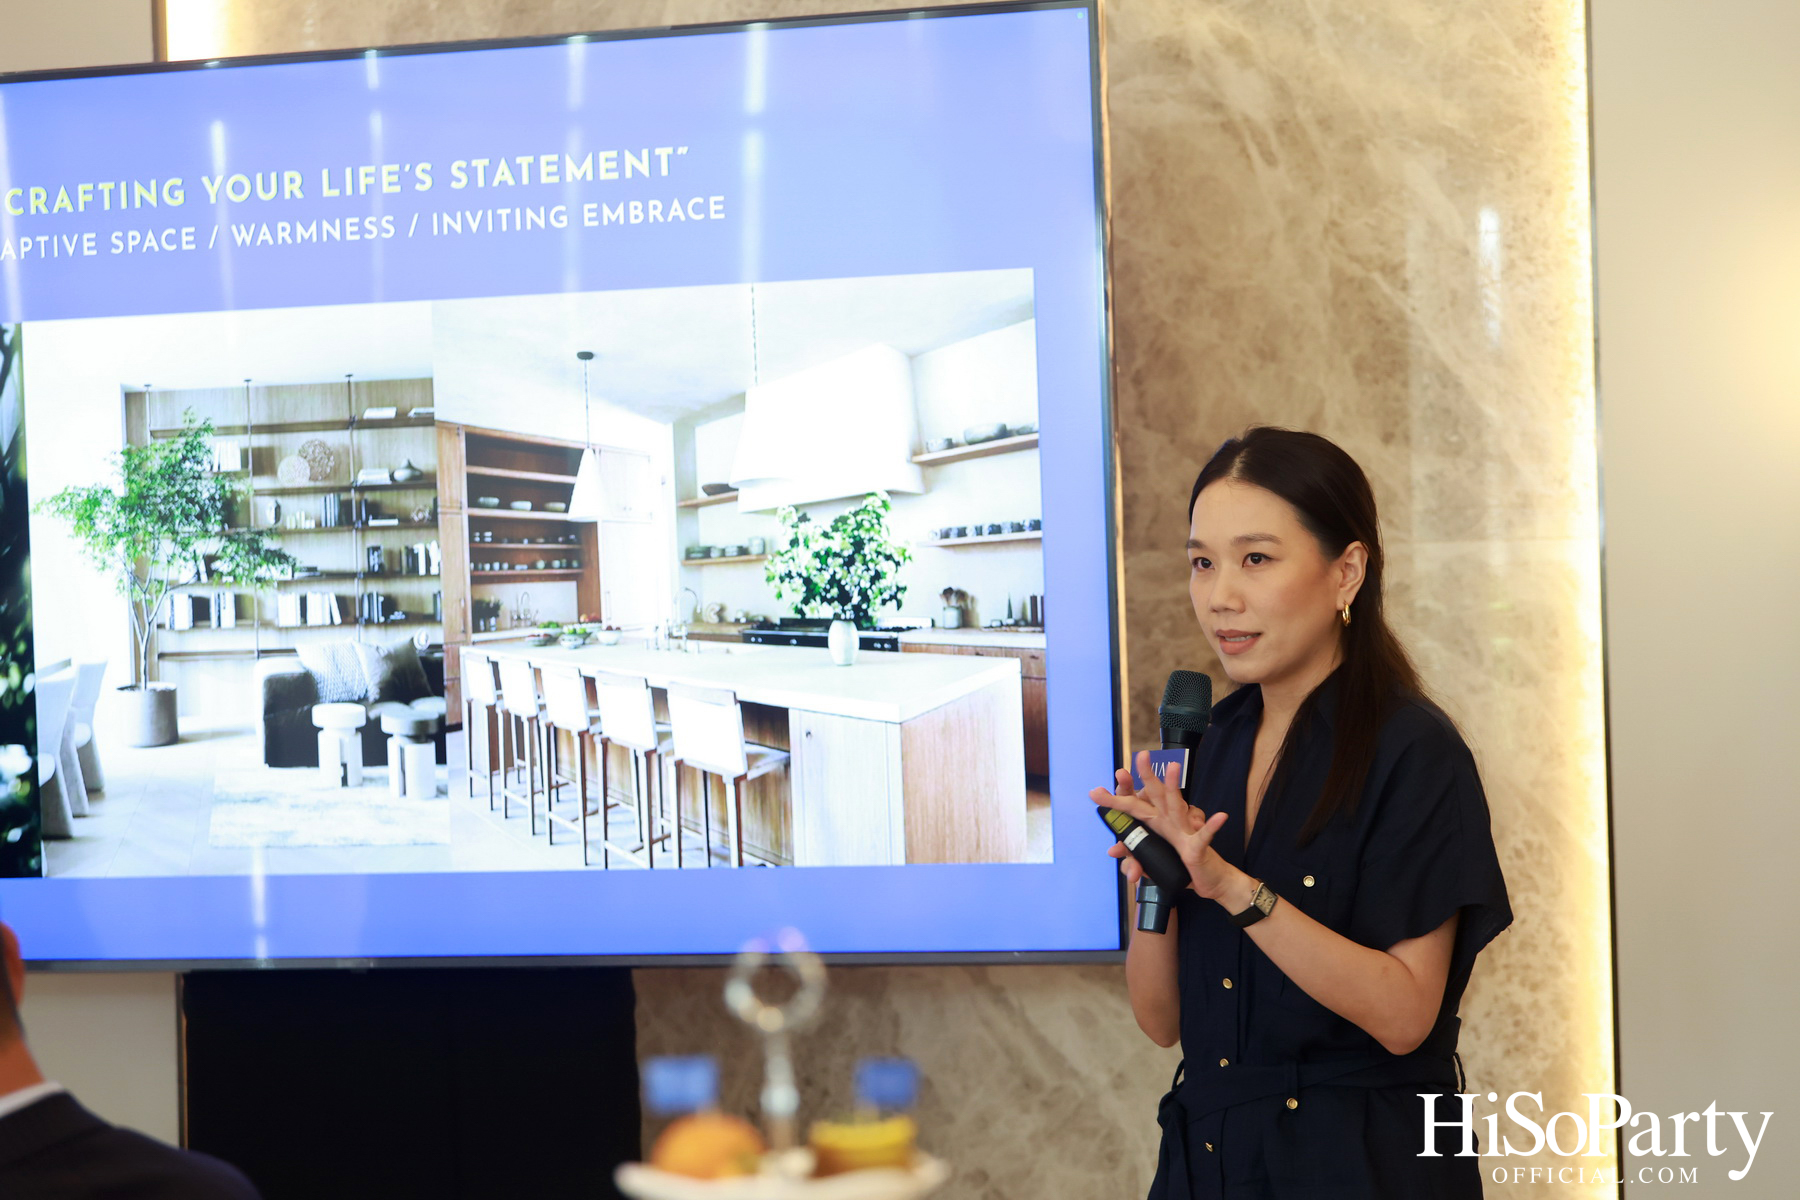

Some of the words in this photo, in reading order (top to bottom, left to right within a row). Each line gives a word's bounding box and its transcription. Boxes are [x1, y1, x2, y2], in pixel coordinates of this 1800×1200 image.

[4, 177, 186, 216] CRAFTING
[201, 170, 304, 205] YOUR
[321, 162, 433, 198] LIFE'S
[110, 226, 197, 255] SPACE
[208, 224, 219, 249] /
[231, 215, 396, 248] WARMNESS
[408, 212, 419, 238] /
[432, 204, 569, 236] INVITING
[583, 195, 726, 227] EMBRACE
